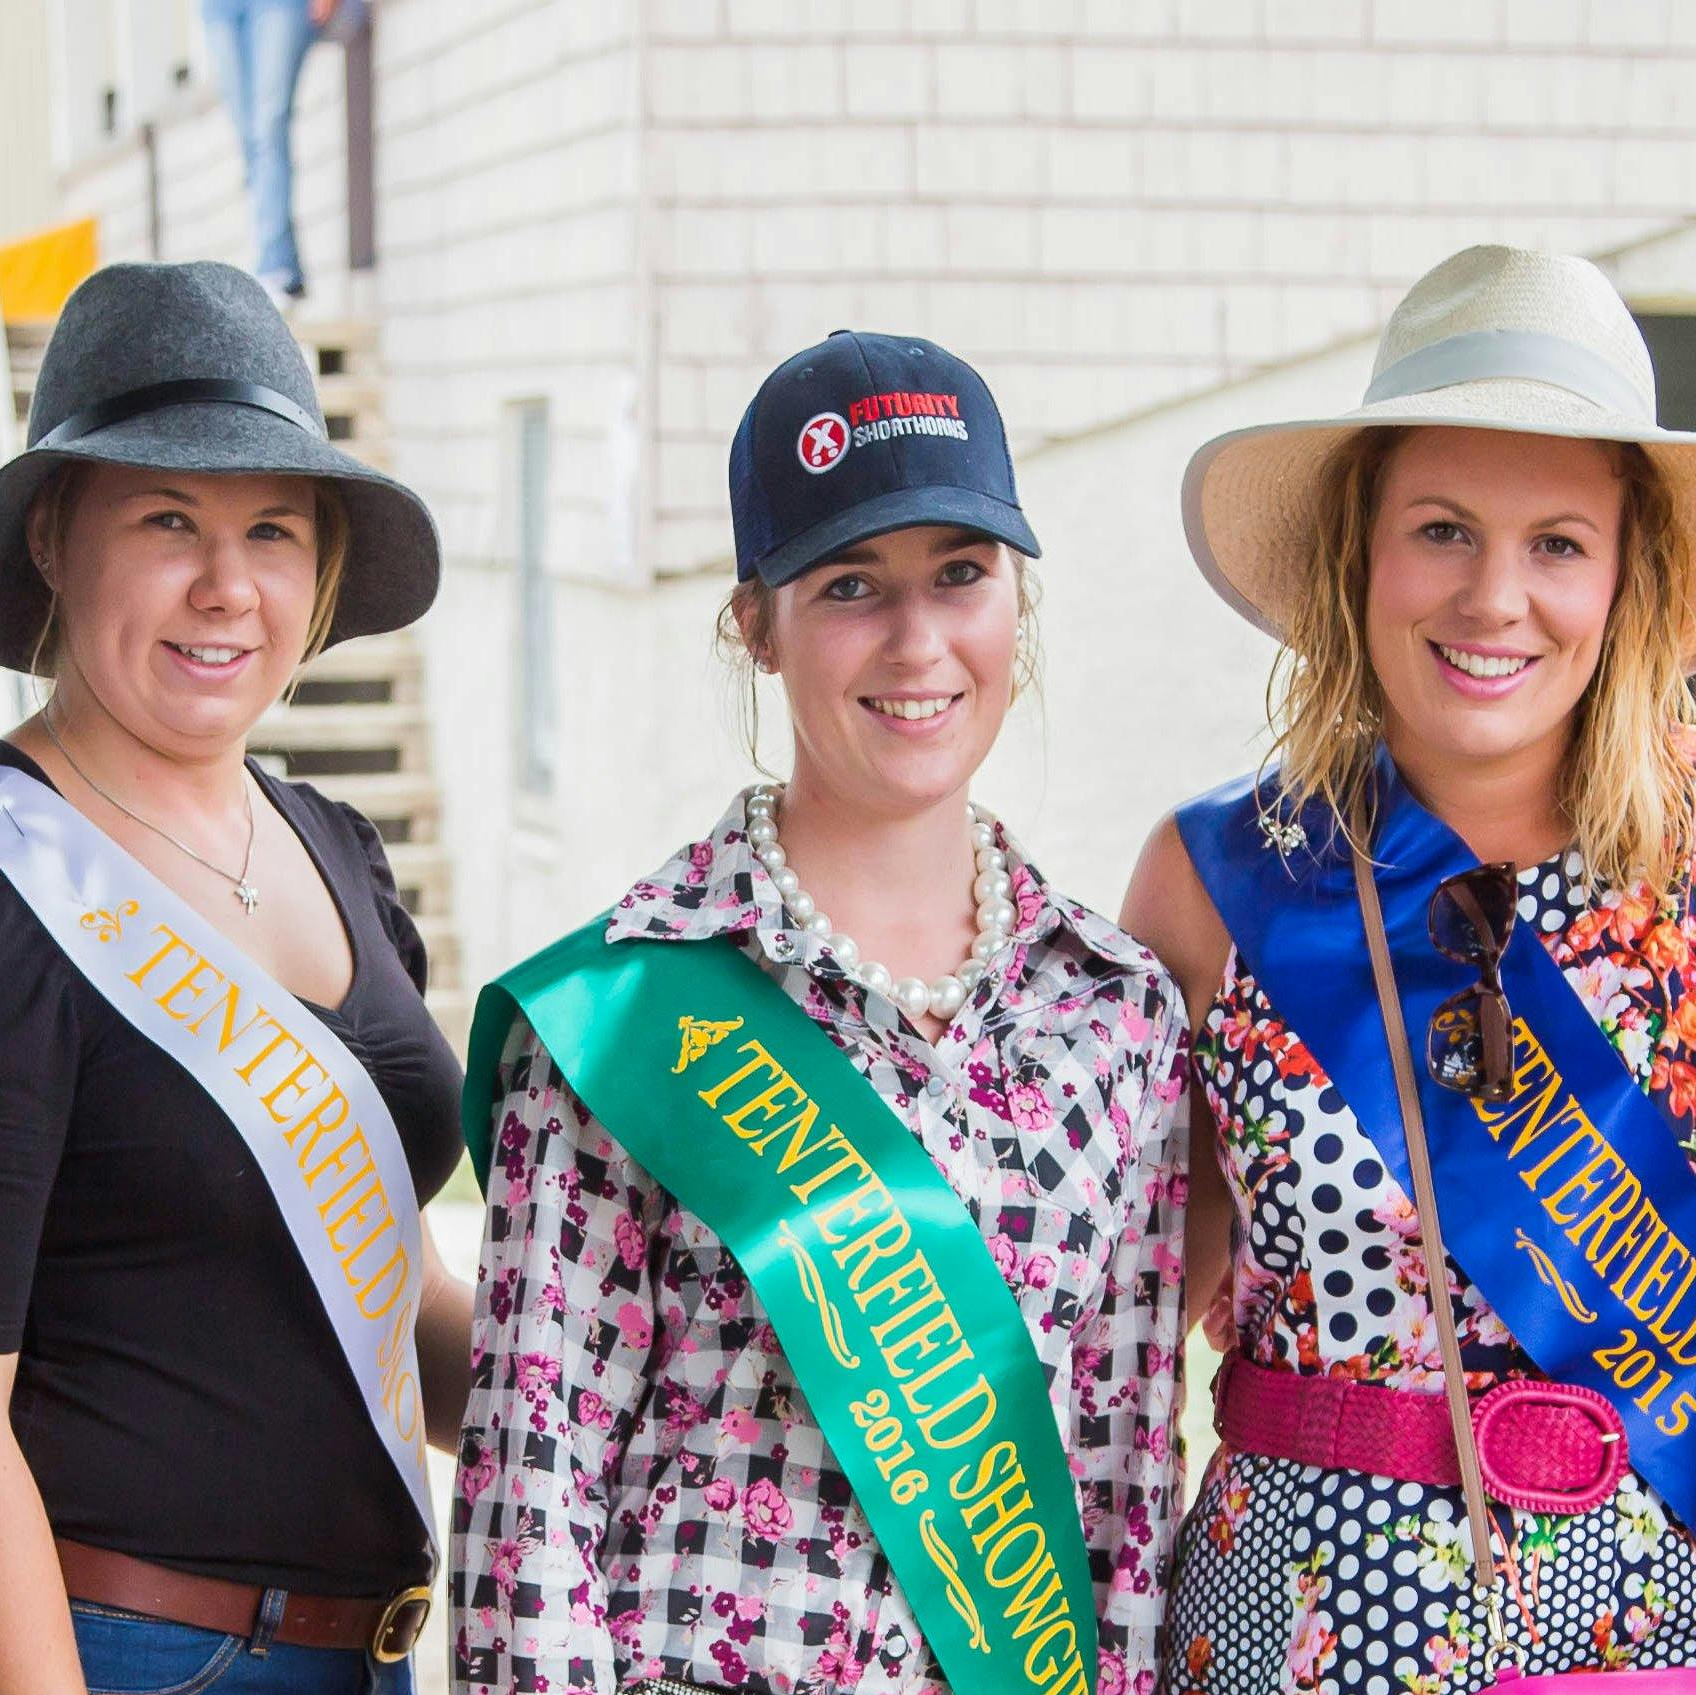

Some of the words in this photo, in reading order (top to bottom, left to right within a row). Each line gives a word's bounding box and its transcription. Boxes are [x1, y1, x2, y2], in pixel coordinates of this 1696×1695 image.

[849, 392, 959, 426] FUTURITY
[853, 415, 969, 448] SHORTHORNS
[124, 922, 410, 1320] TENTERFIELD
[698, 1037, 998, 1451] TENTERFIELD
[848, 1387, 930, 1507] 2016
